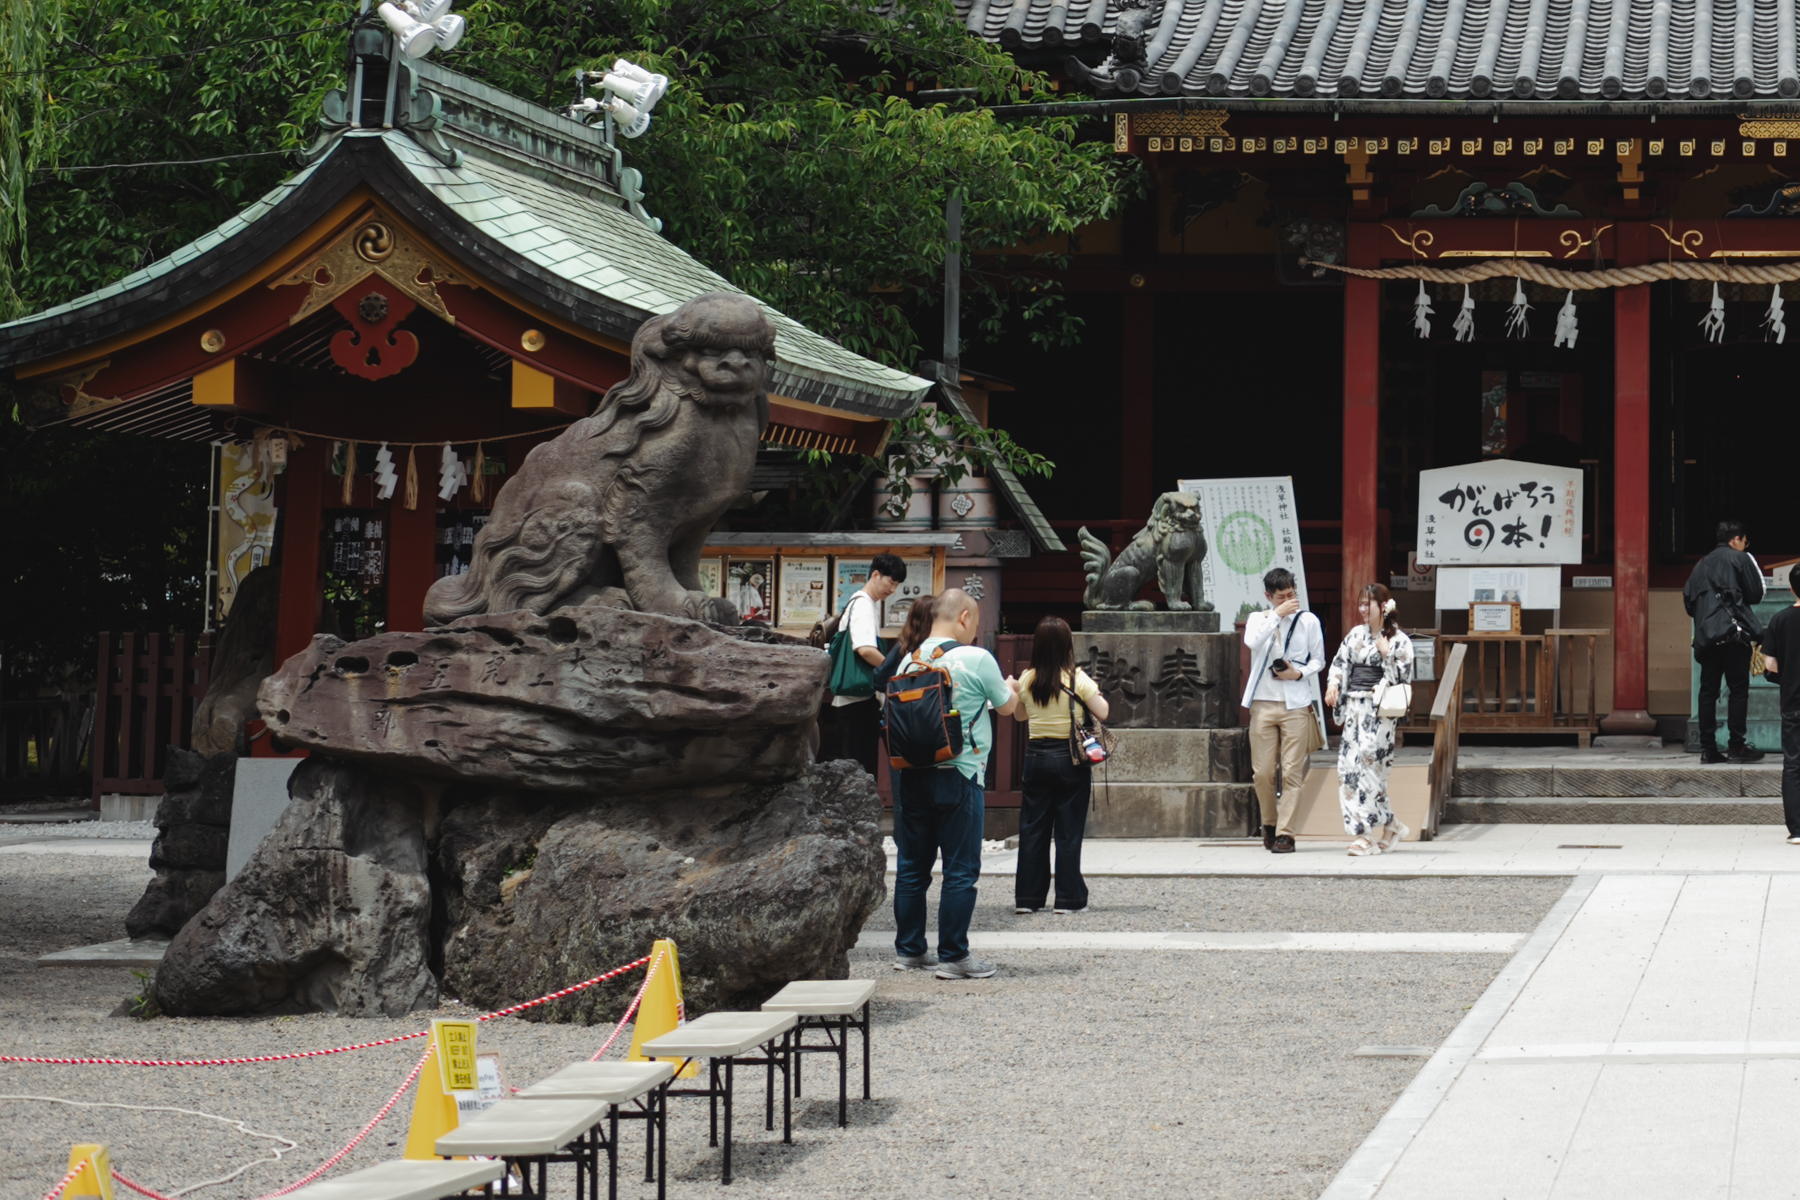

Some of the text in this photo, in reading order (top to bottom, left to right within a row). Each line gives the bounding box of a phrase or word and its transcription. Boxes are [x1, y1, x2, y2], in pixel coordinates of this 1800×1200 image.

[1438, 481, 1555, 516] がんばろう
